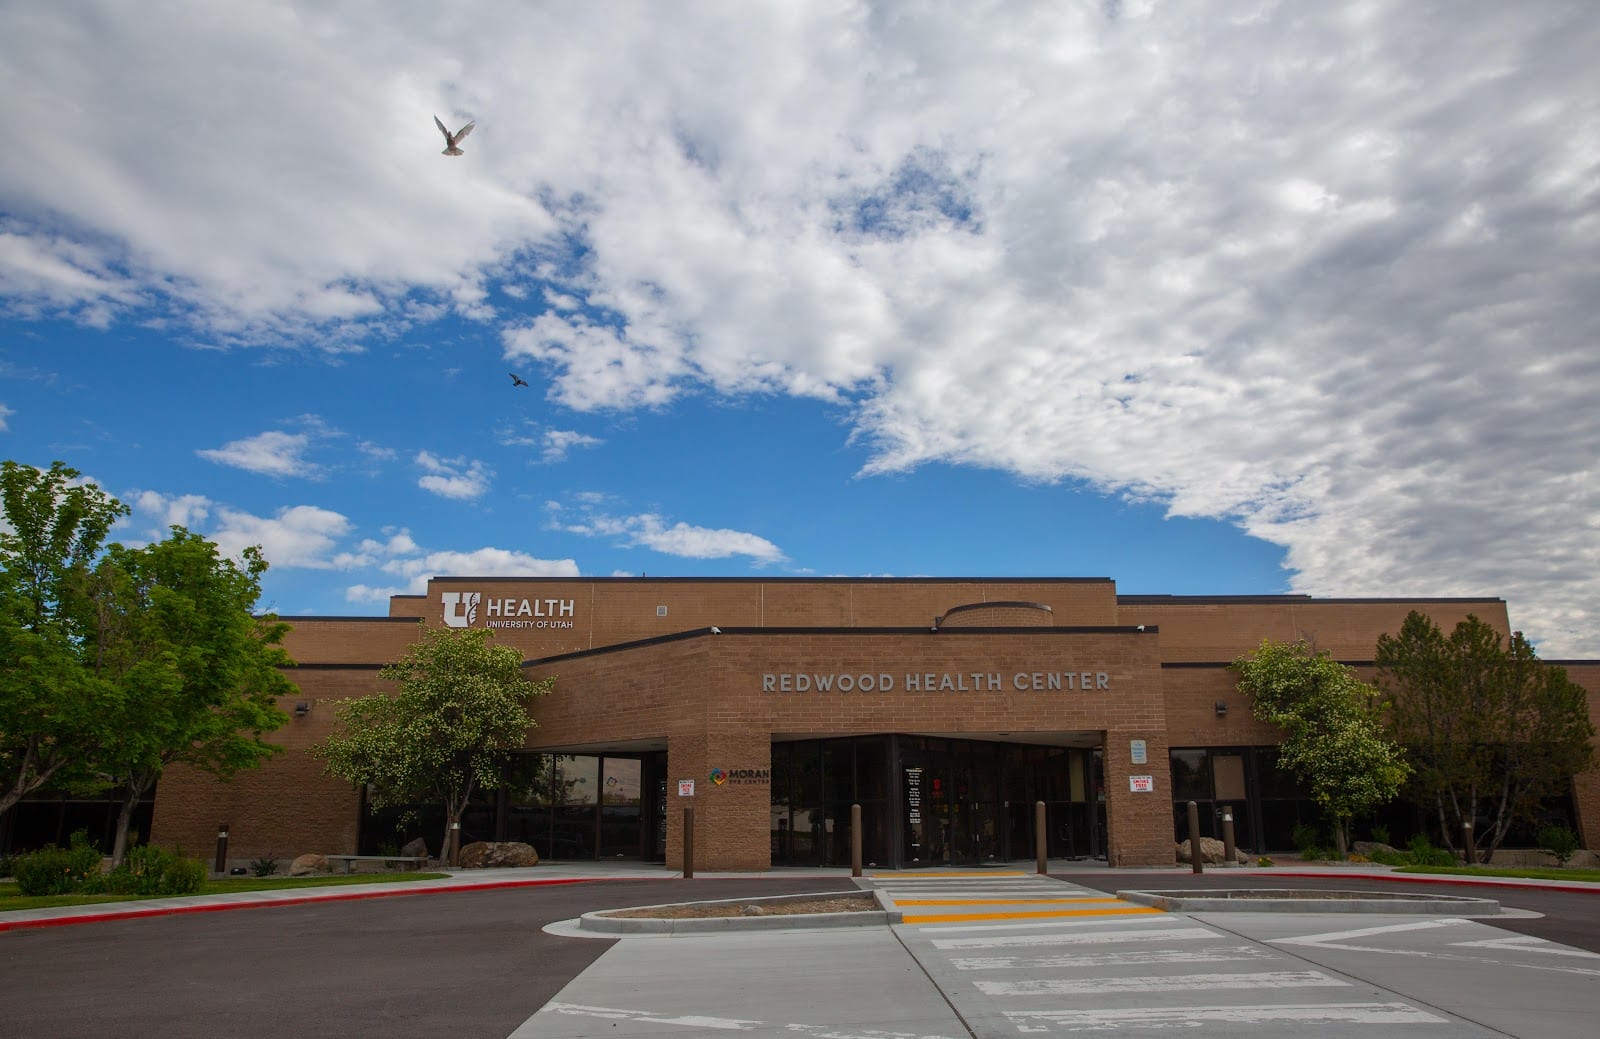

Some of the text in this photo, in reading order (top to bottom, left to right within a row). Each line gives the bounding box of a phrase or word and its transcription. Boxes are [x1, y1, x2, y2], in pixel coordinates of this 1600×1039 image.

[486, 599, 574, 617] HEALTH
[486, 620, 573, 629] UNIVERSITY OF UTAH
[762, 672, 1110, 692] REDWOOD HEALTH CENTER
[729, 769, 769, 778] MORAN
